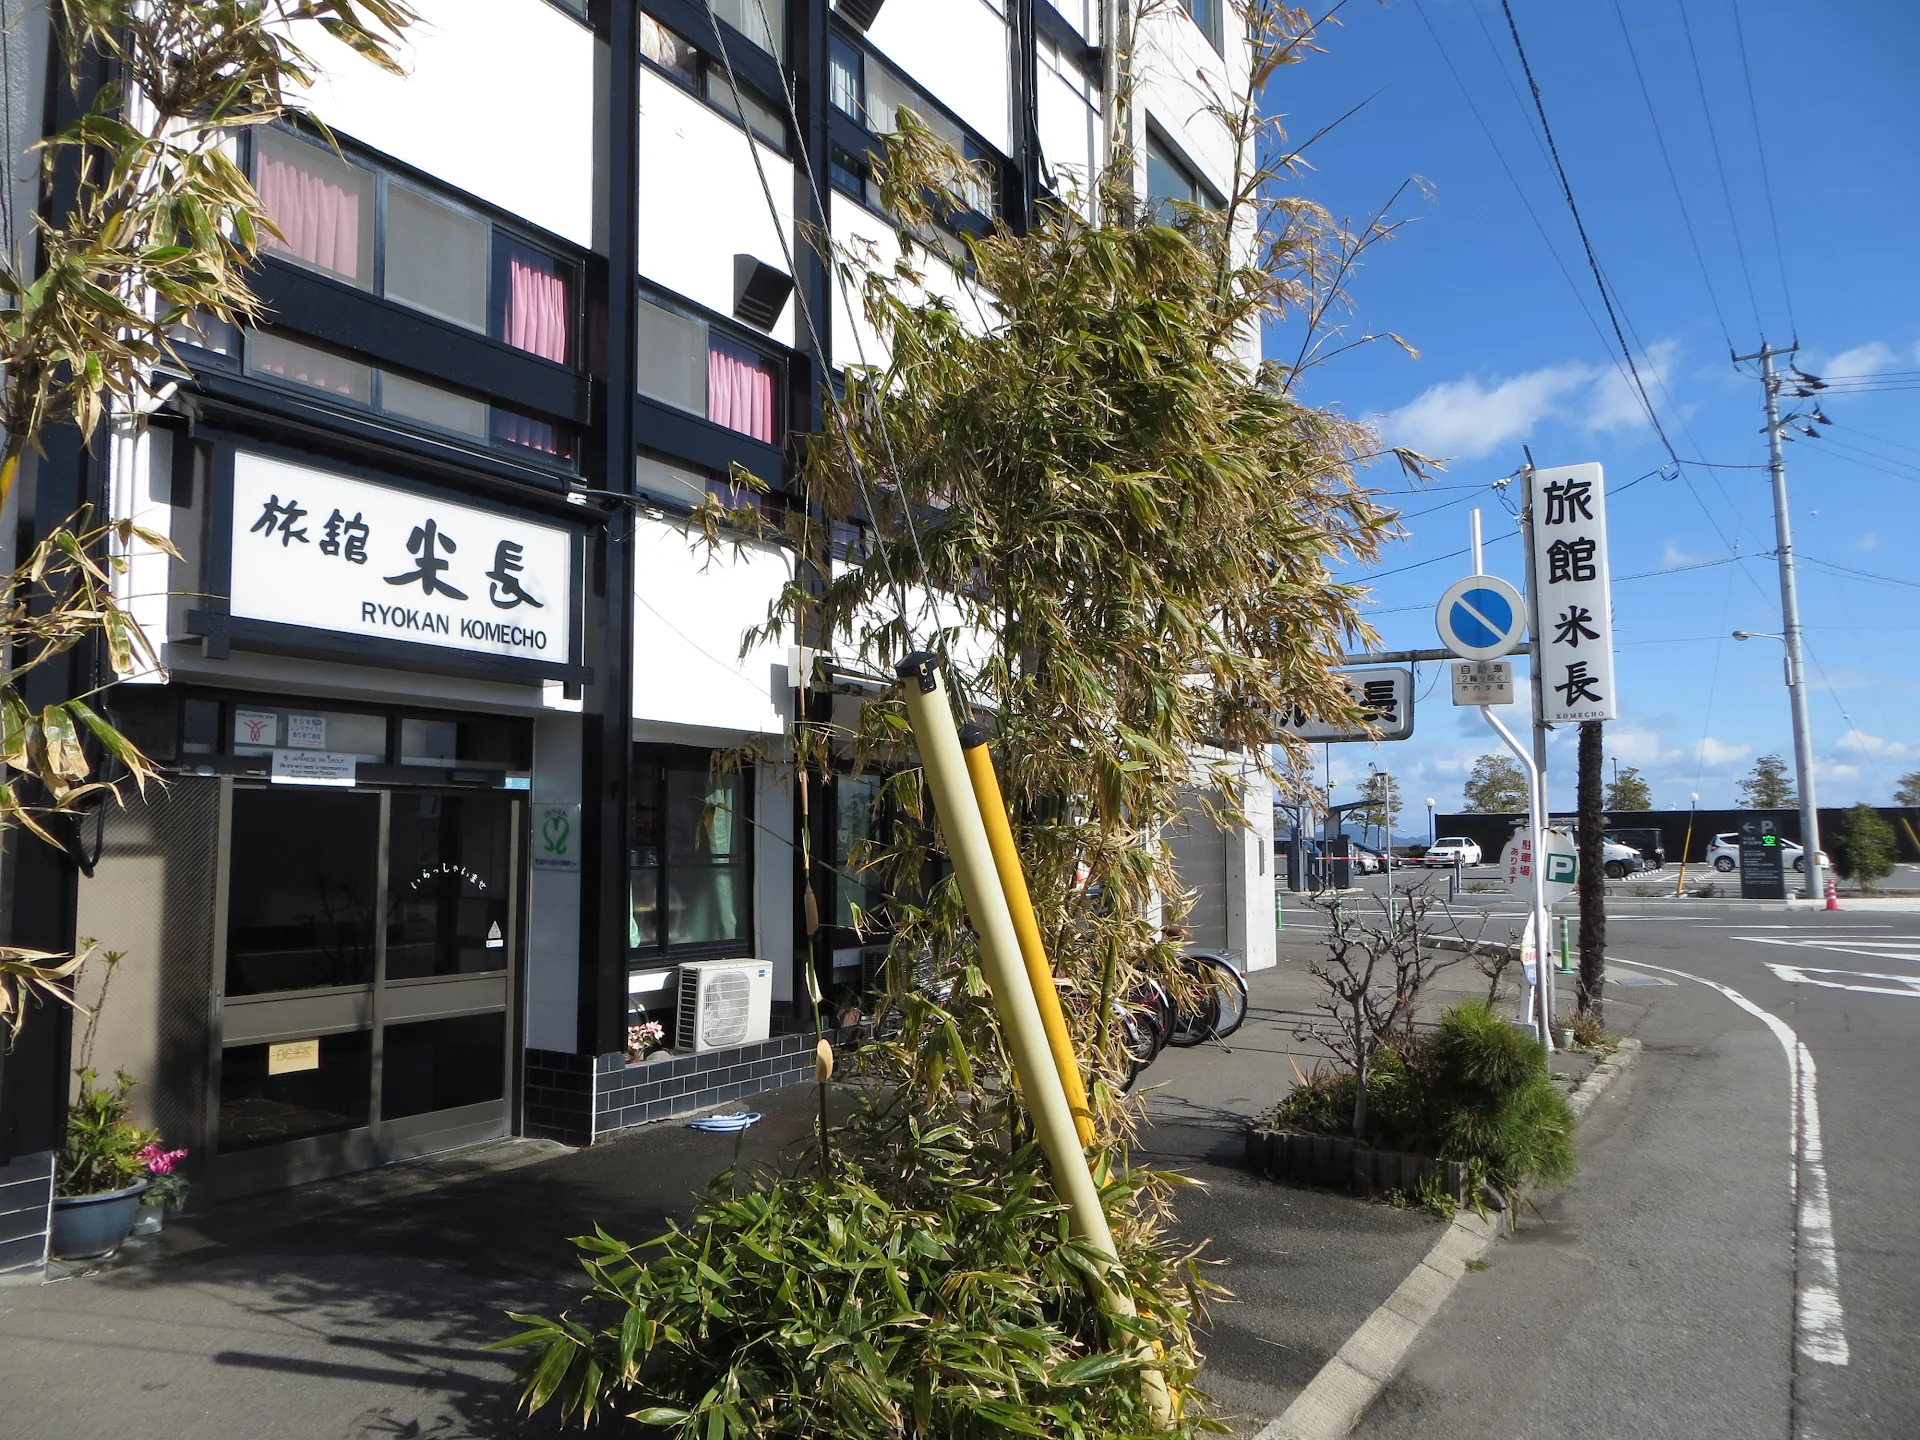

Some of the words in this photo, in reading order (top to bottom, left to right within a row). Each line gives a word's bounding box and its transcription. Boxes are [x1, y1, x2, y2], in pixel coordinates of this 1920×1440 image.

[361, 601, 450, 635] RYOKAN
[460, 617, 548, 650] KOMECHO
[1556, 711, 1605, 720] KOMECHO
[1762, 834, 1777, 847] 空
[1508, 847, 1519, 884] あります
[1520, 840, 1531, 876] 駐車場
[1548, 855, 1574, 880] P
[410, 863, 487, 890] いらっしゃいませ
